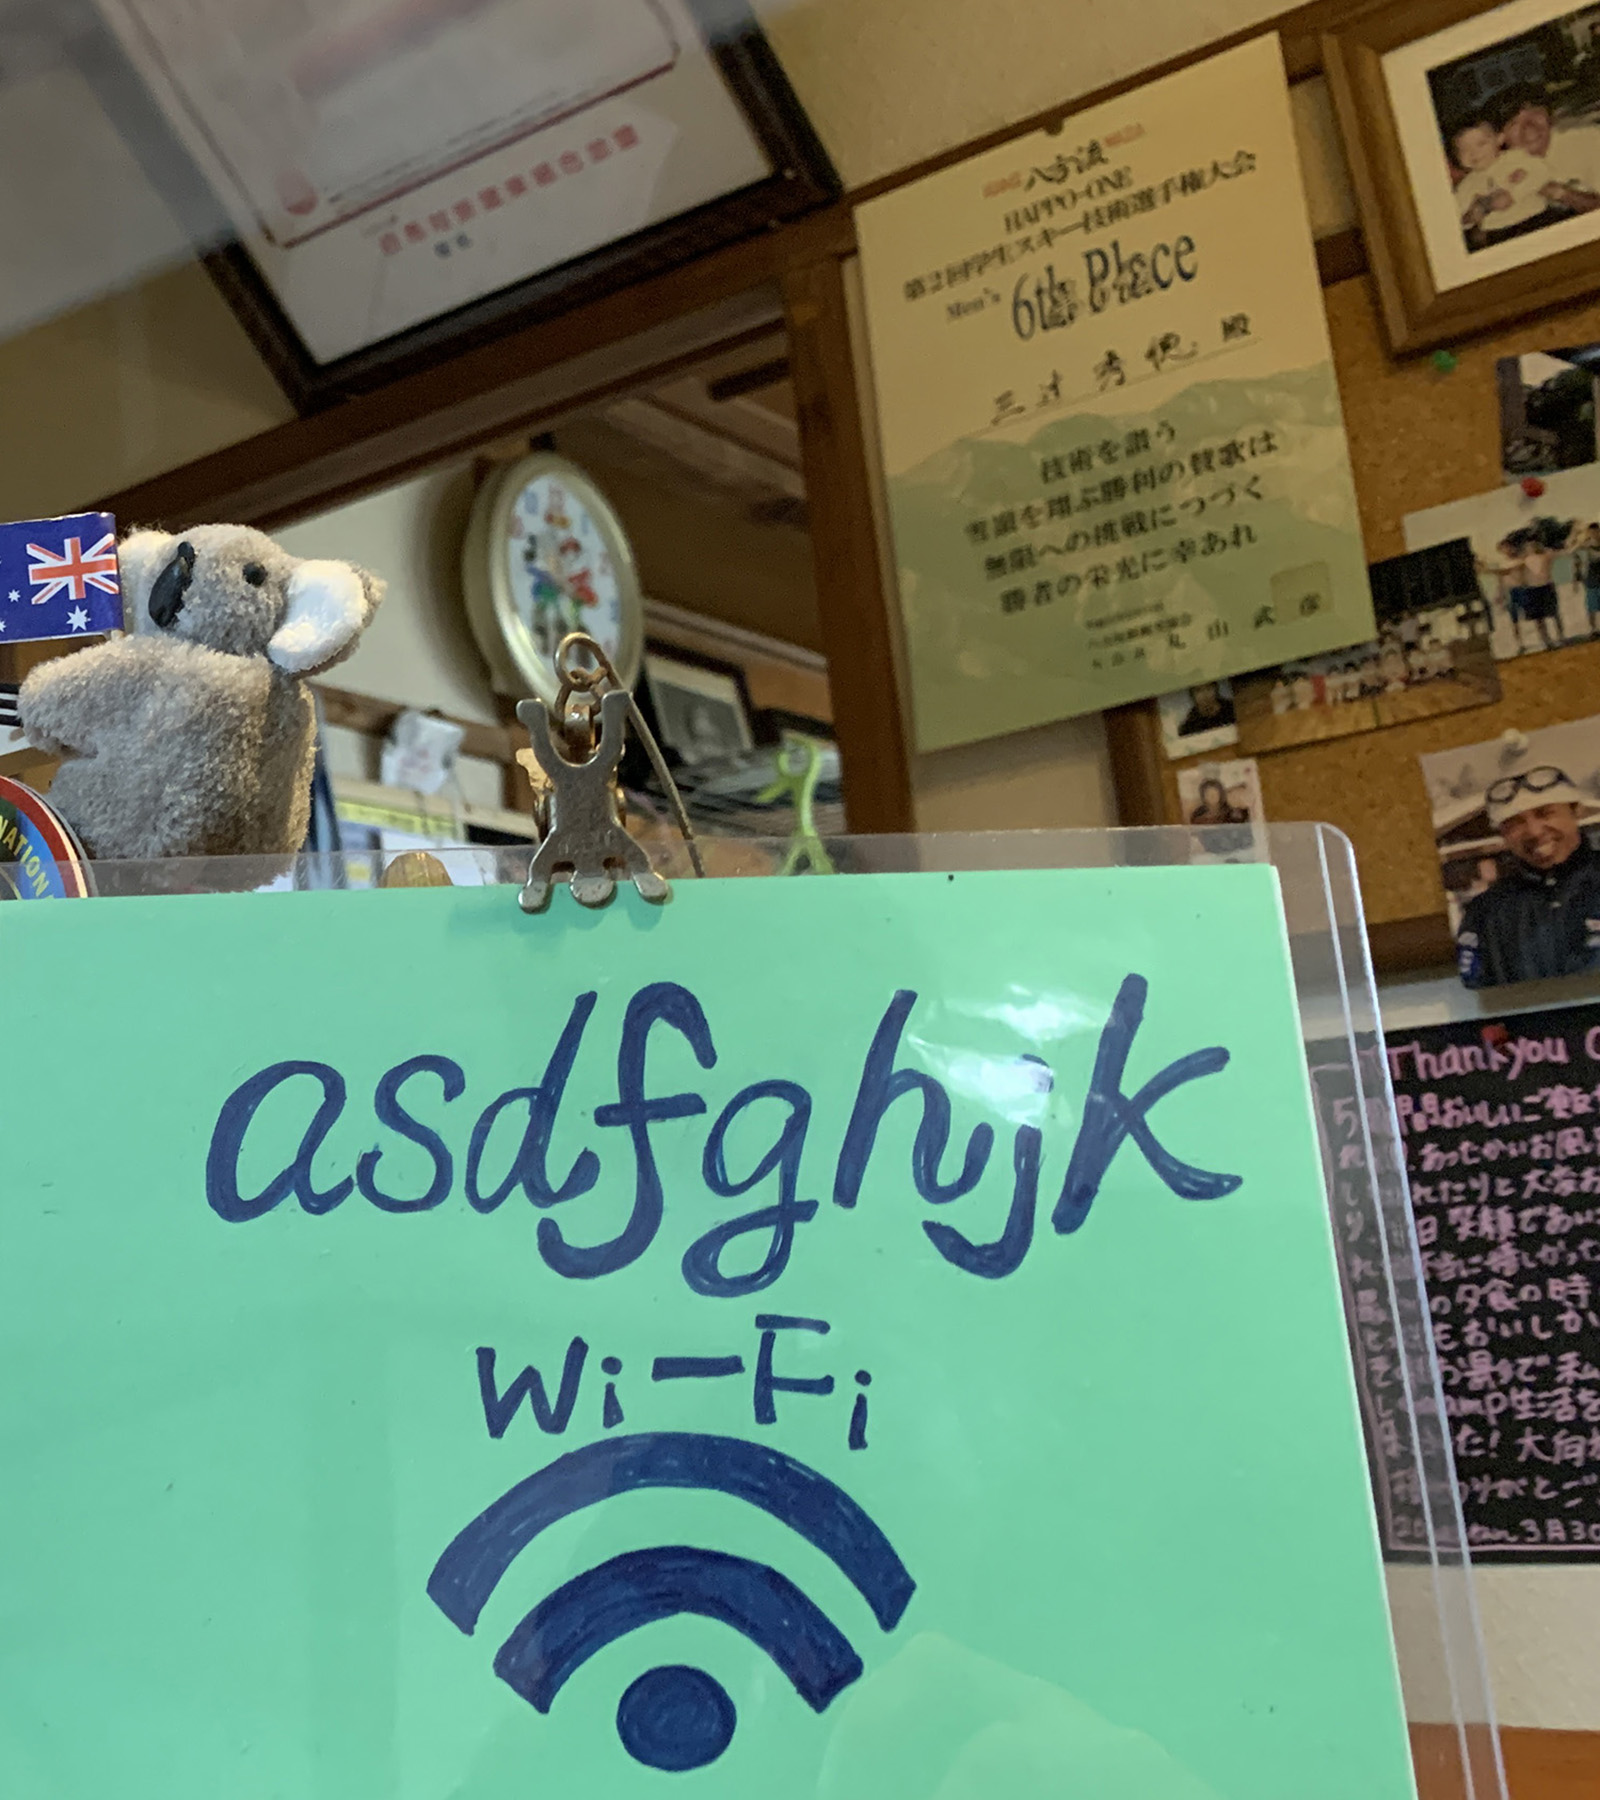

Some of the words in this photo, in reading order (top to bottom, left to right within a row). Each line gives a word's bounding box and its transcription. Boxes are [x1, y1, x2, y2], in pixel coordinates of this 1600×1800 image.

[1012, 262, 1074, 341] 6th
[1085, 233, 1198, 314] Place
[1000, 524, 1258, 614] 勝者の栄光に幸あれ
[1385, 1040, 1508, 1081] Thank
[1507, 1036, 1568, 1081] you
[206, 972, 1243, 1297] asdfghjk
[475, 1314, 872, 1451] Wi-Fi
